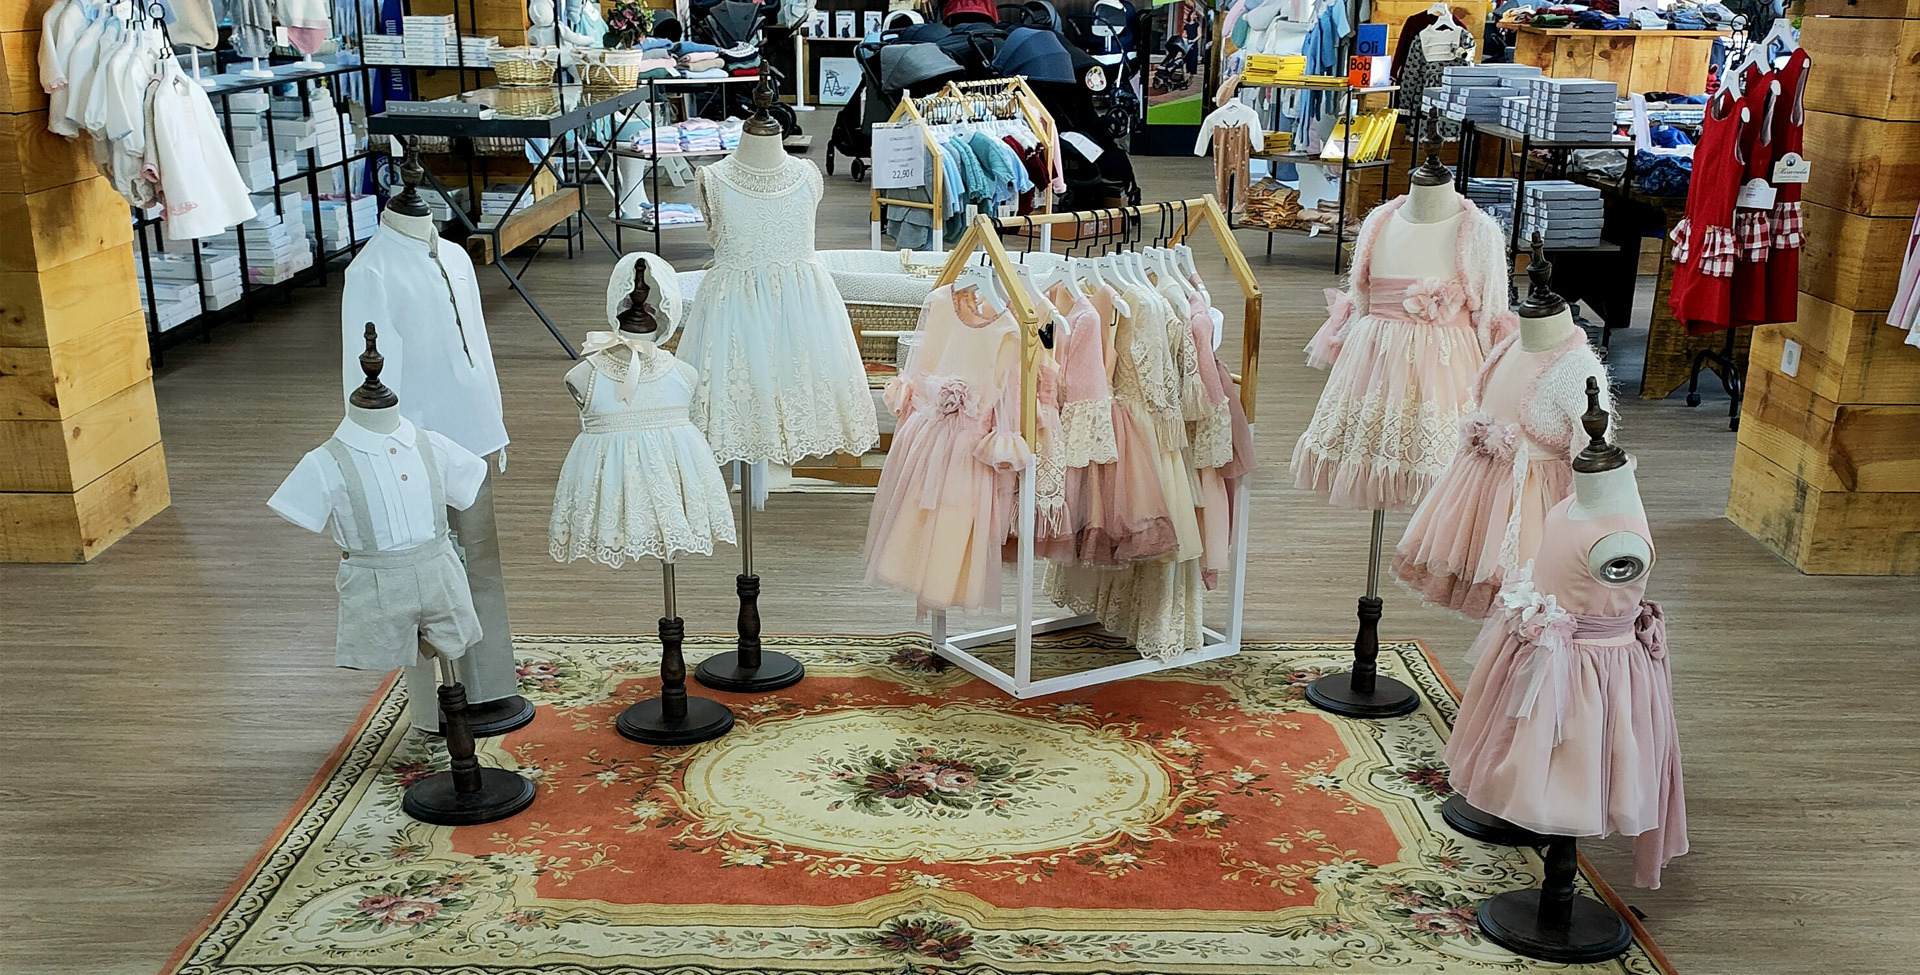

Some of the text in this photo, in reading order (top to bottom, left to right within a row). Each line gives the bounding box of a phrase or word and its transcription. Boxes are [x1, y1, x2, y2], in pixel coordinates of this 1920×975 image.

[1359, 41, 1379, 54] Oli
[1350, 58, 1371, 71] Bob
[1361, 72, 1370, 85] &
[892, 169, 909, 179] 22,90
